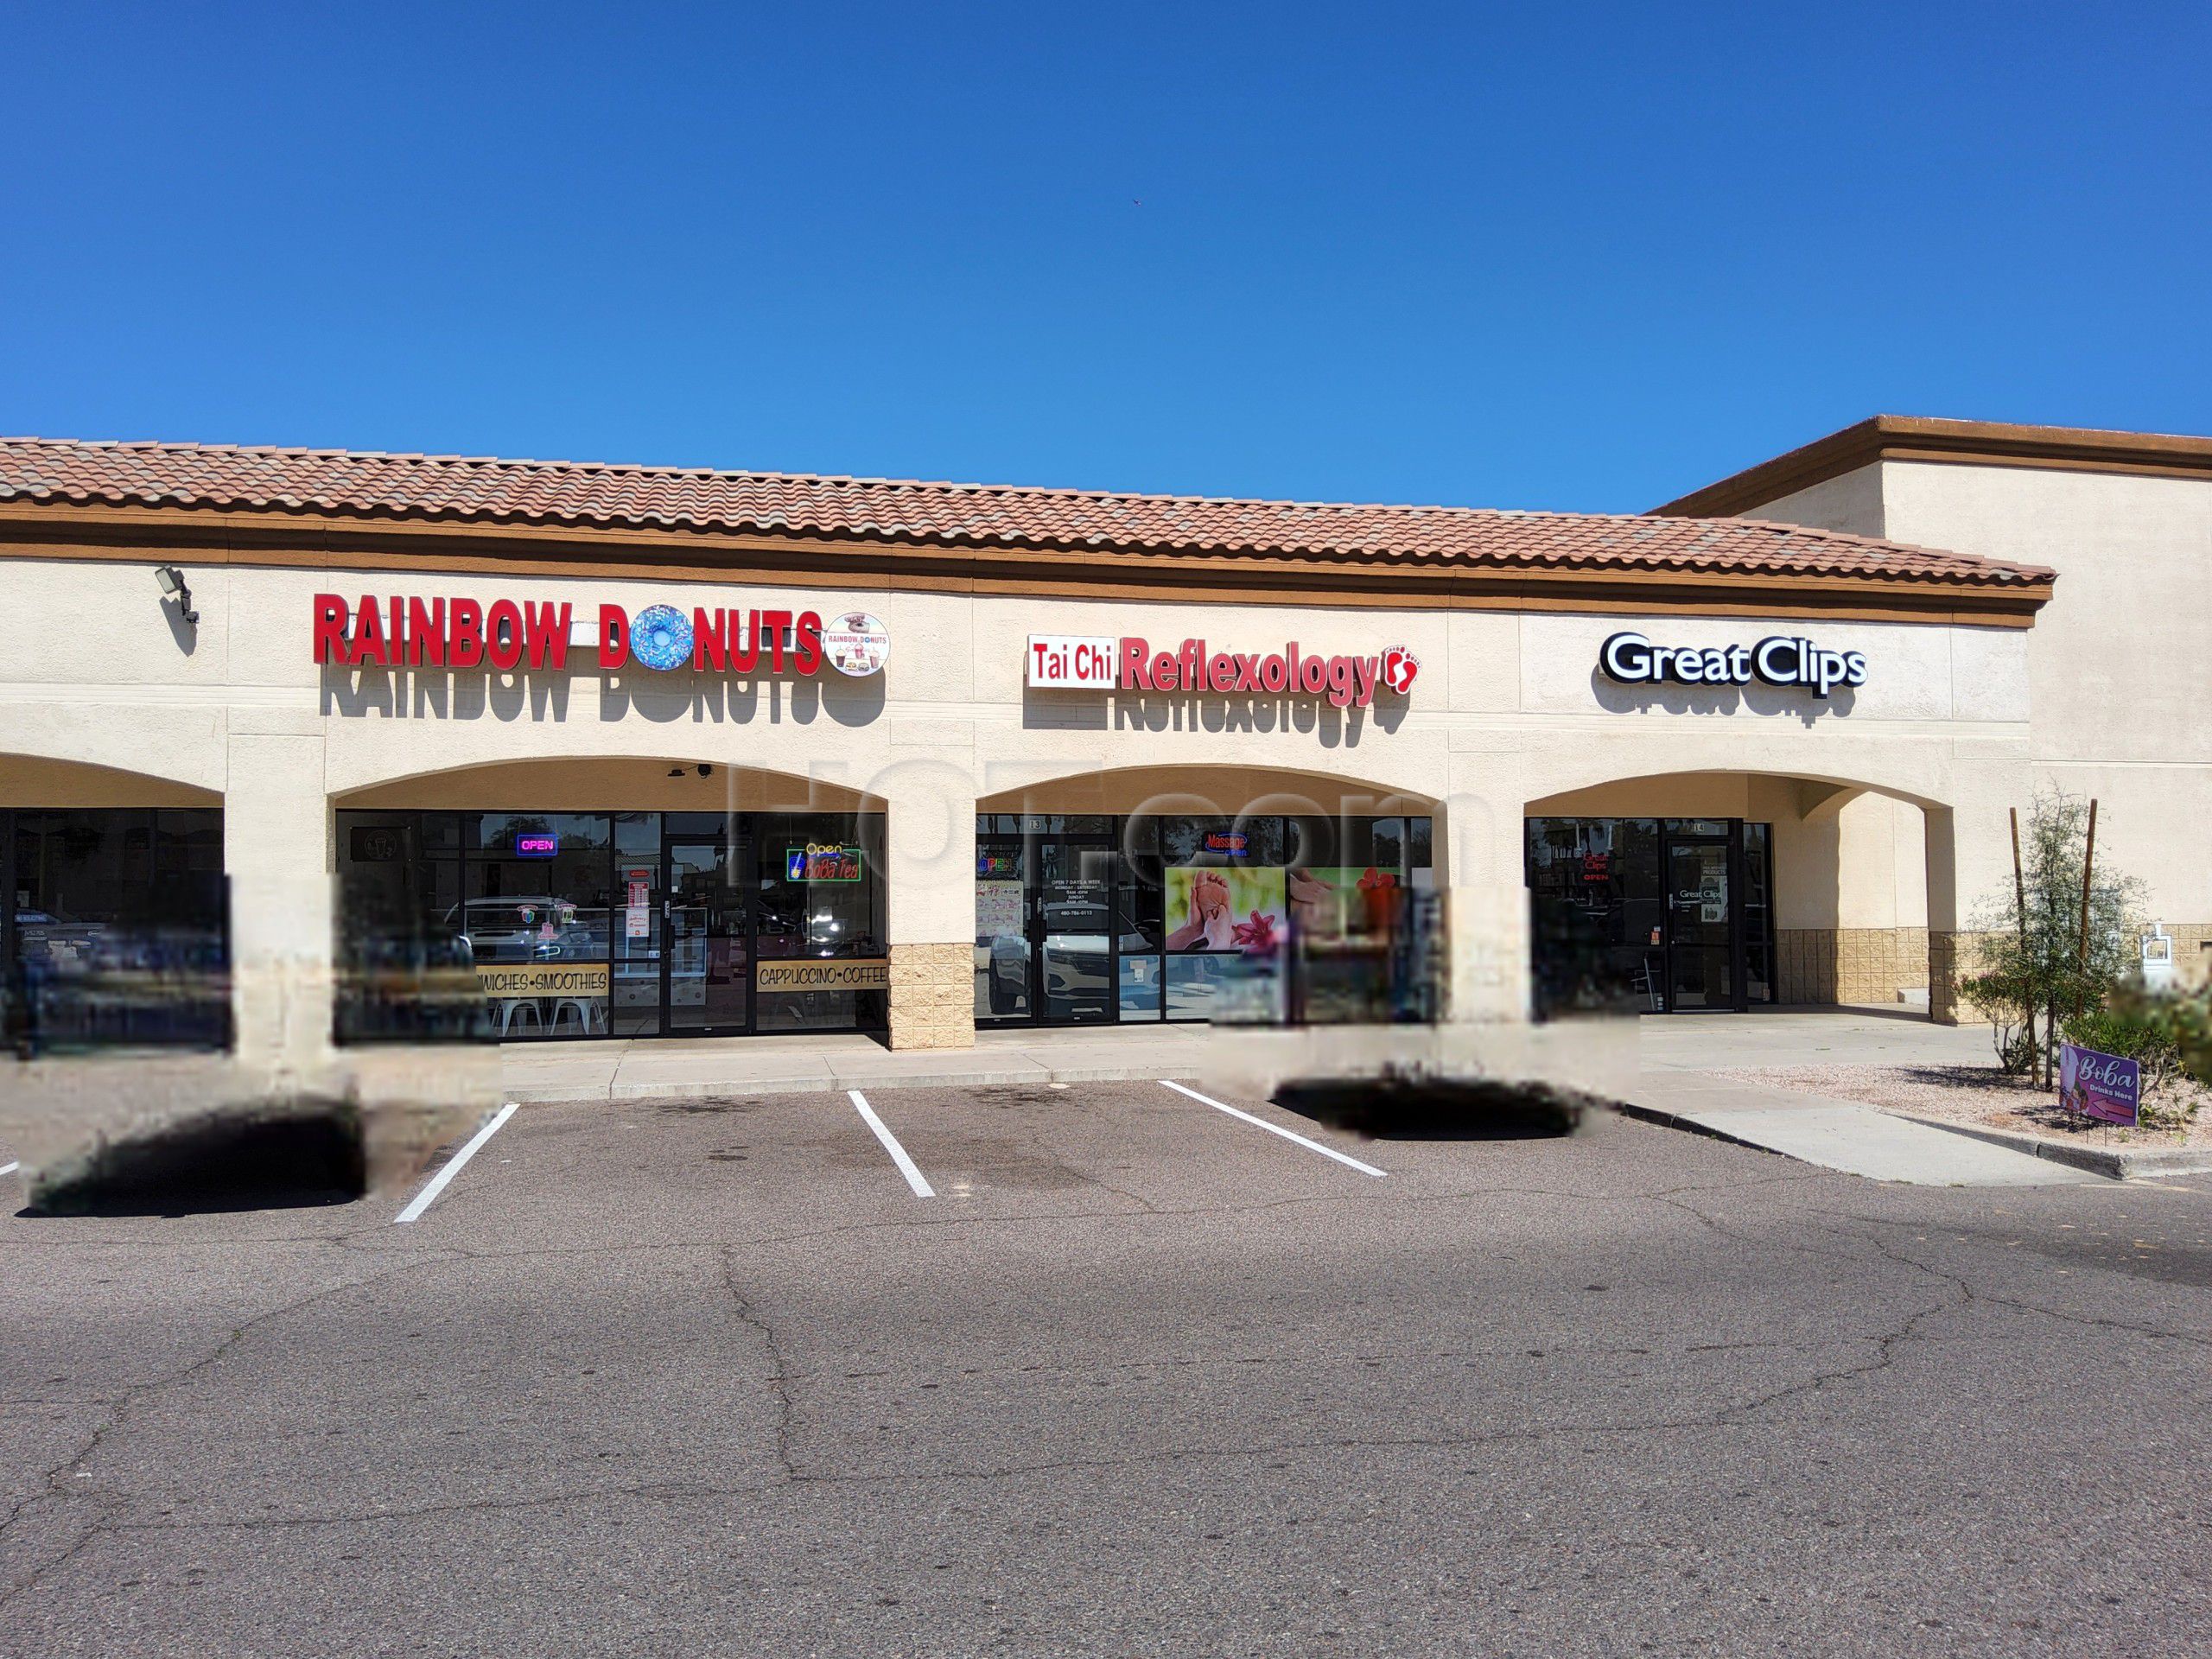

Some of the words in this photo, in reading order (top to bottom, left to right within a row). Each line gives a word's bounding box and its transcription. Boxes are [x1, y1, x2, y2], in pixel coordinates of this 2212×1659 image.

[313, 593, 573, 671] RAINBOW
[1033, 643, 1068, 680] Tai
[1074, 643, 1112, 681] Chi
[1602, 632, 1751, 684] Great
[1752, 635, 1868, 698] Clips
[1118, 637, 1381, 709] Reflexology
[1030, 820, 1040, 829] 13
[521, 840, 554, 850] OPEN
[806, 842, 842, 857] Open
[1207, 833, 1245, 849] Massage
[839, 857, 858, 879] Tea
[977, 857, 1013, 872] OPEN
[1679, 889, 1702, 898] Great
[1703, 890, 1722, 900] Clips
[535, 972, 607, 990] SMOOTHIES
[760, 967, 836, 986] CAPPUCCINO
[842, 966, 887, 983] COFFEE
[2078, 1055, 2136, 1088] Boba
[2089, 1084, 2114, 1096] Drinks
[2114, 1090, 2133, 1101] Here
